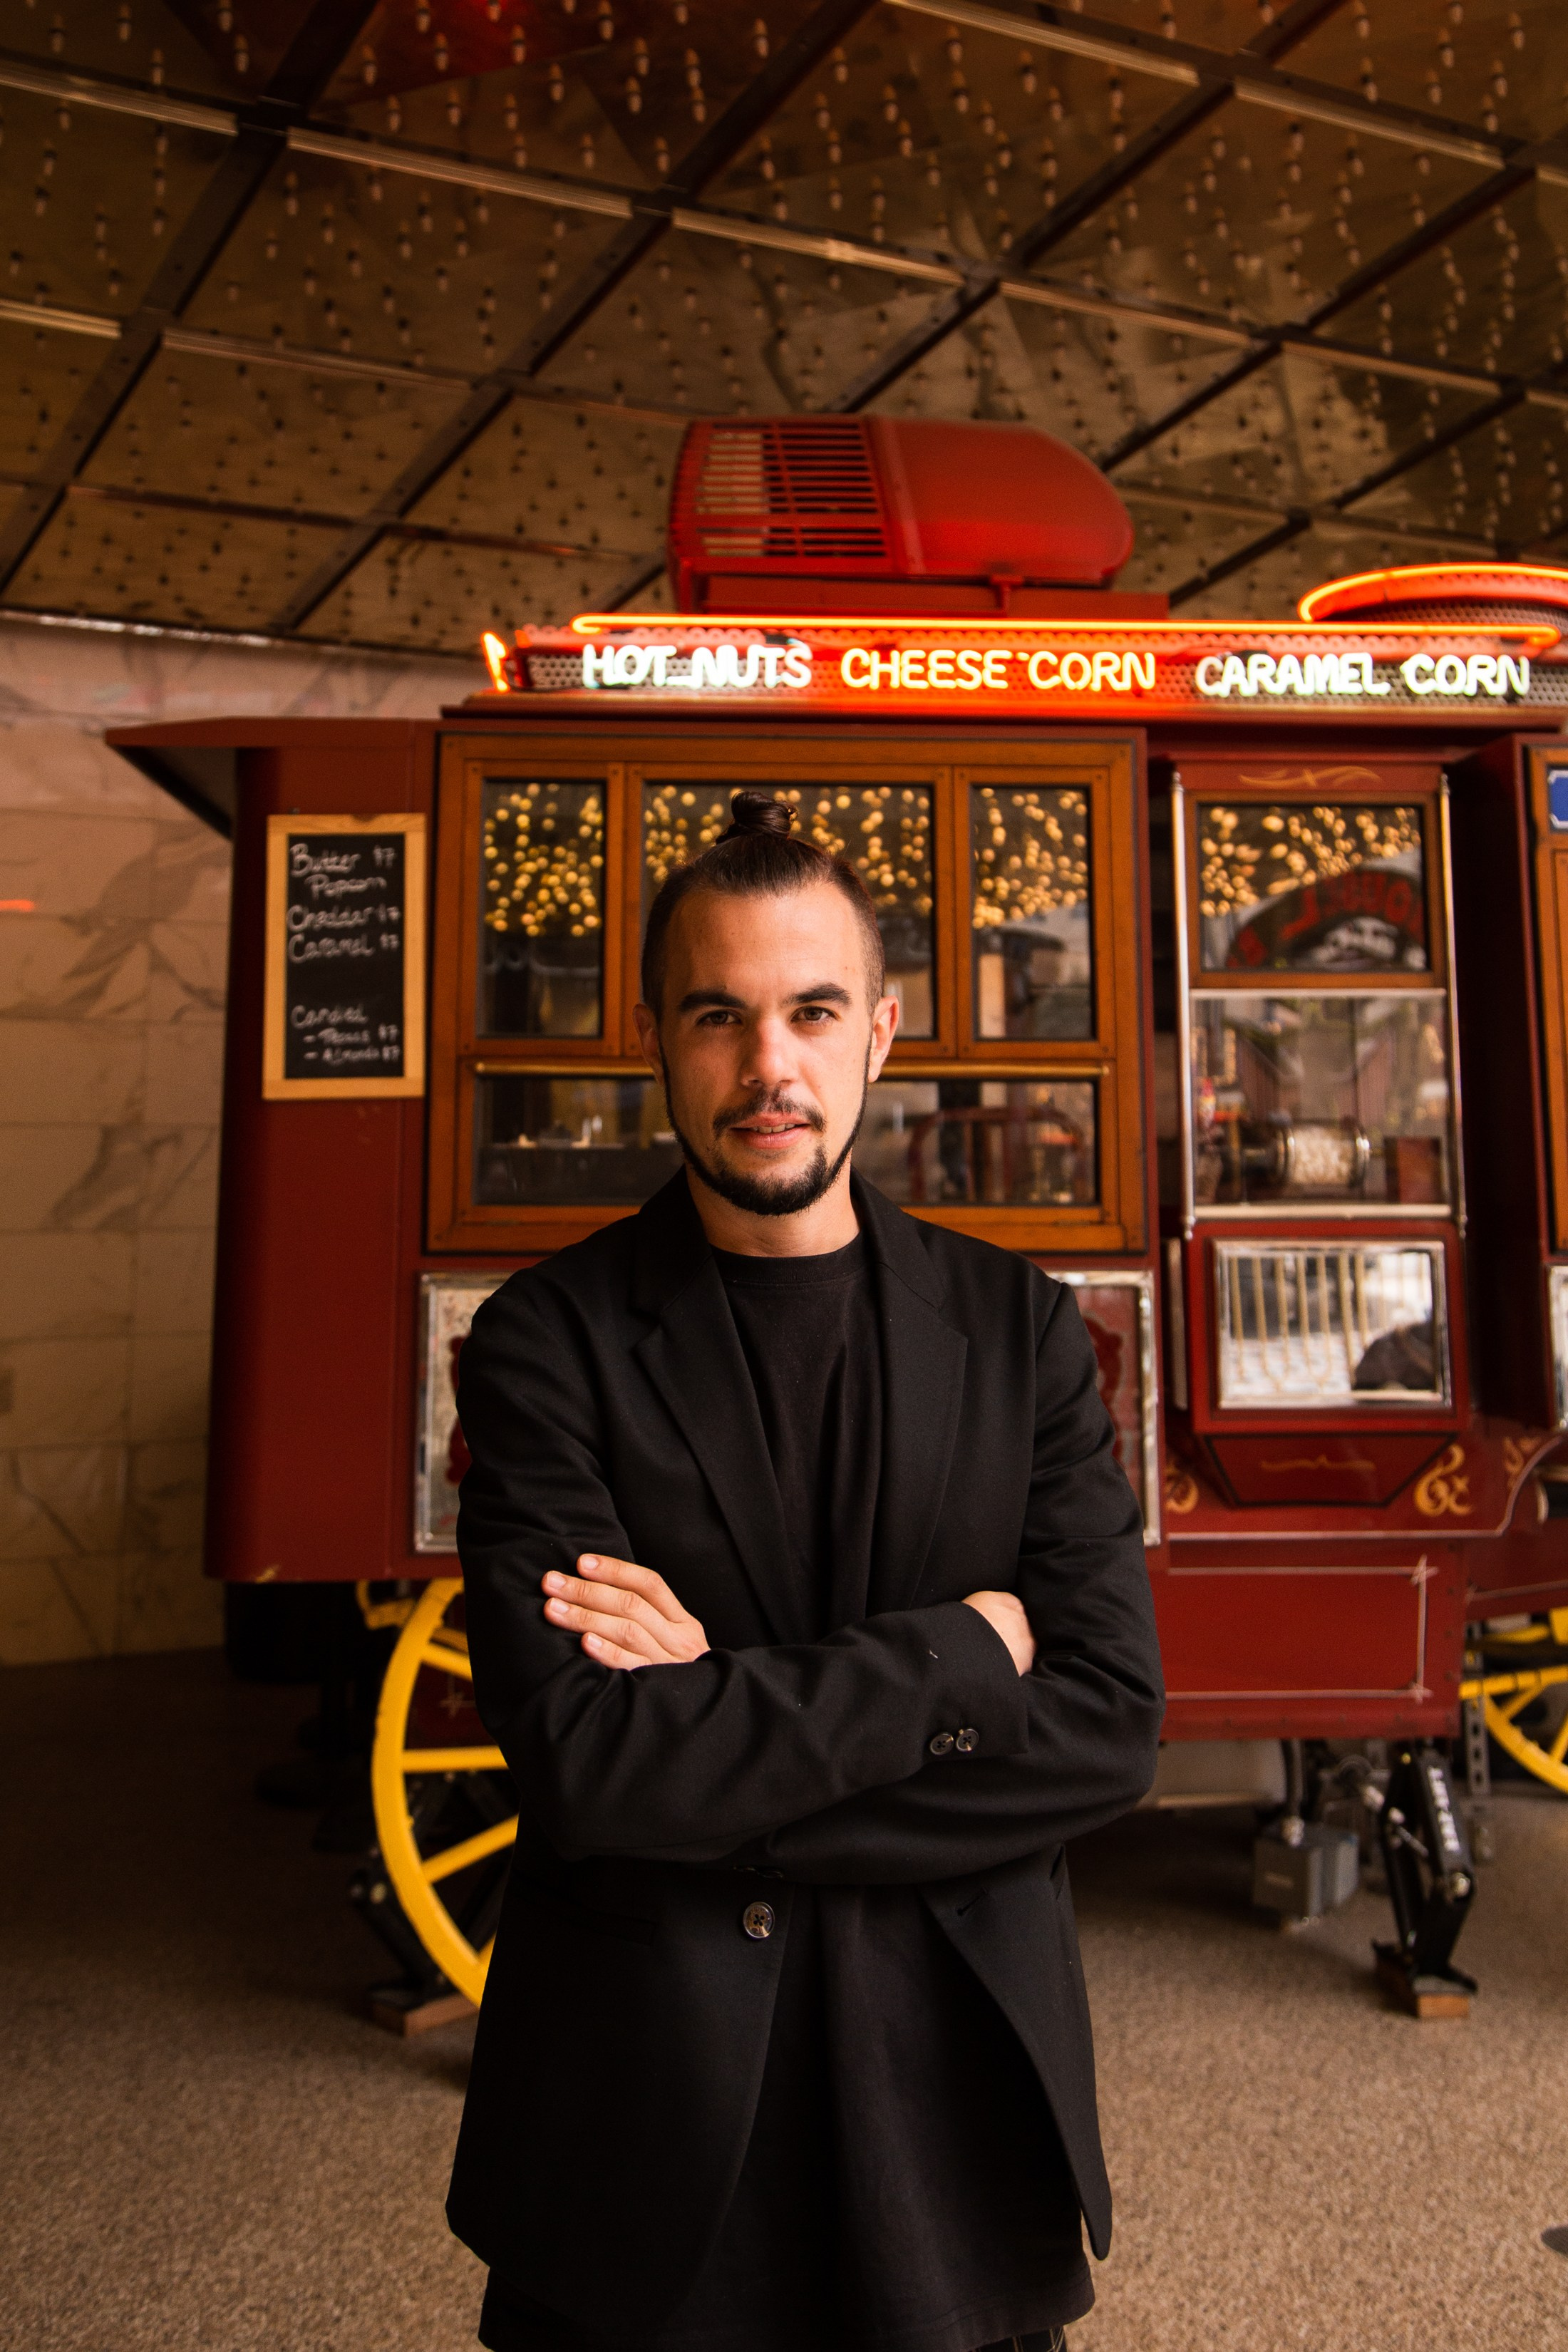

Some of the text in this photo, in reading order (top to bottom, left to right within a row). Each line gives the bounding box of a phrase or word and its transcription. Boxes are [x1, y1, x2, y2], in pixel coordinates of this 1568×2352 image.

[582, 639, 813, 688] HOT NUTS
[841, 648, 1156, 691] CHEESE CORN
[1195, 652, 1530, 698] CARAMEL CORN
[290, 843, 361, 877] Butter
[305, 874, 387, 899] Popcorn
[287, 904, 375, 932] Cheddar
